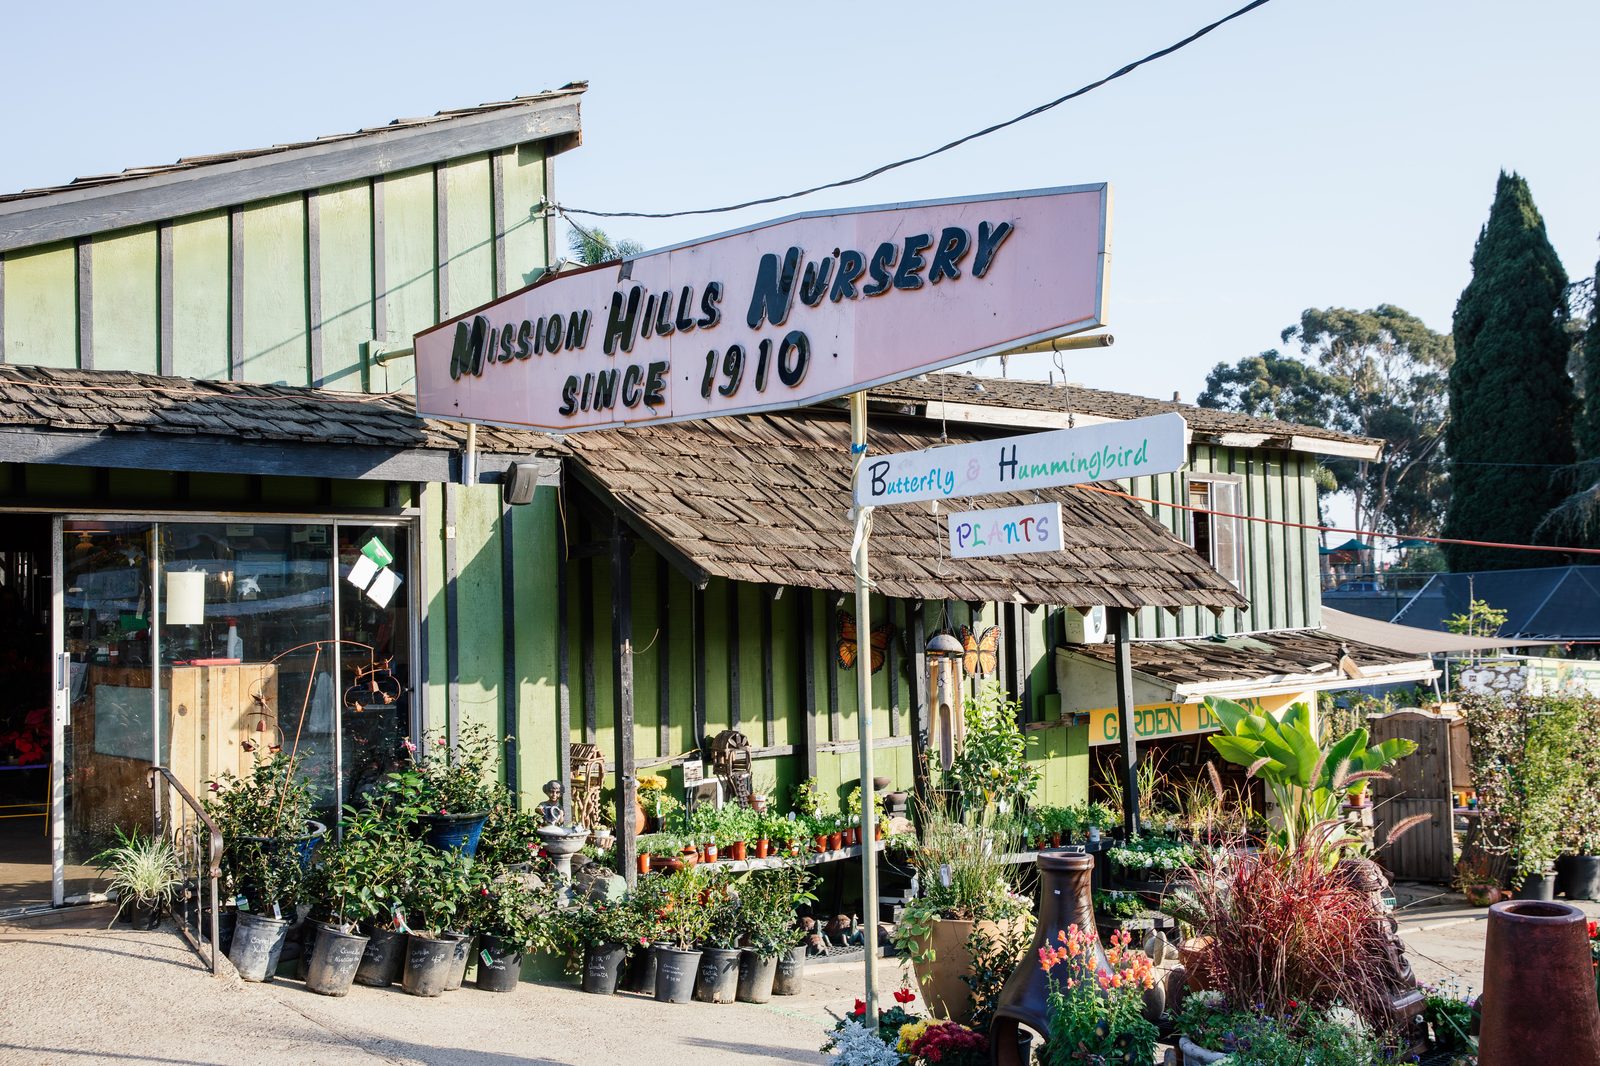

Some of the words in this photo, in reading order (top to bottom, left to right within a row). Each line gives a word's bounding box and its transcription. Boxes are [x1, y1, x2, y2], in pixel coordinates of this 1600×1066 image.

[450, 309, 592, 381] MISSION
[603, 281, 724, 356] HILLS
[747, 220, 1014, 330] NURSERY
[558, 361, 671, 416] SINCE
[700, 330, 811, 400] 1910
[868, 461, 955, 497] Butterfly
[966, 458, 980, 481] &
[998, 438, 1148, 482] Hummingbird
[956, 516, 1049, 548] PLANTS
[1103, 706, 1182, 740] GRDEN
